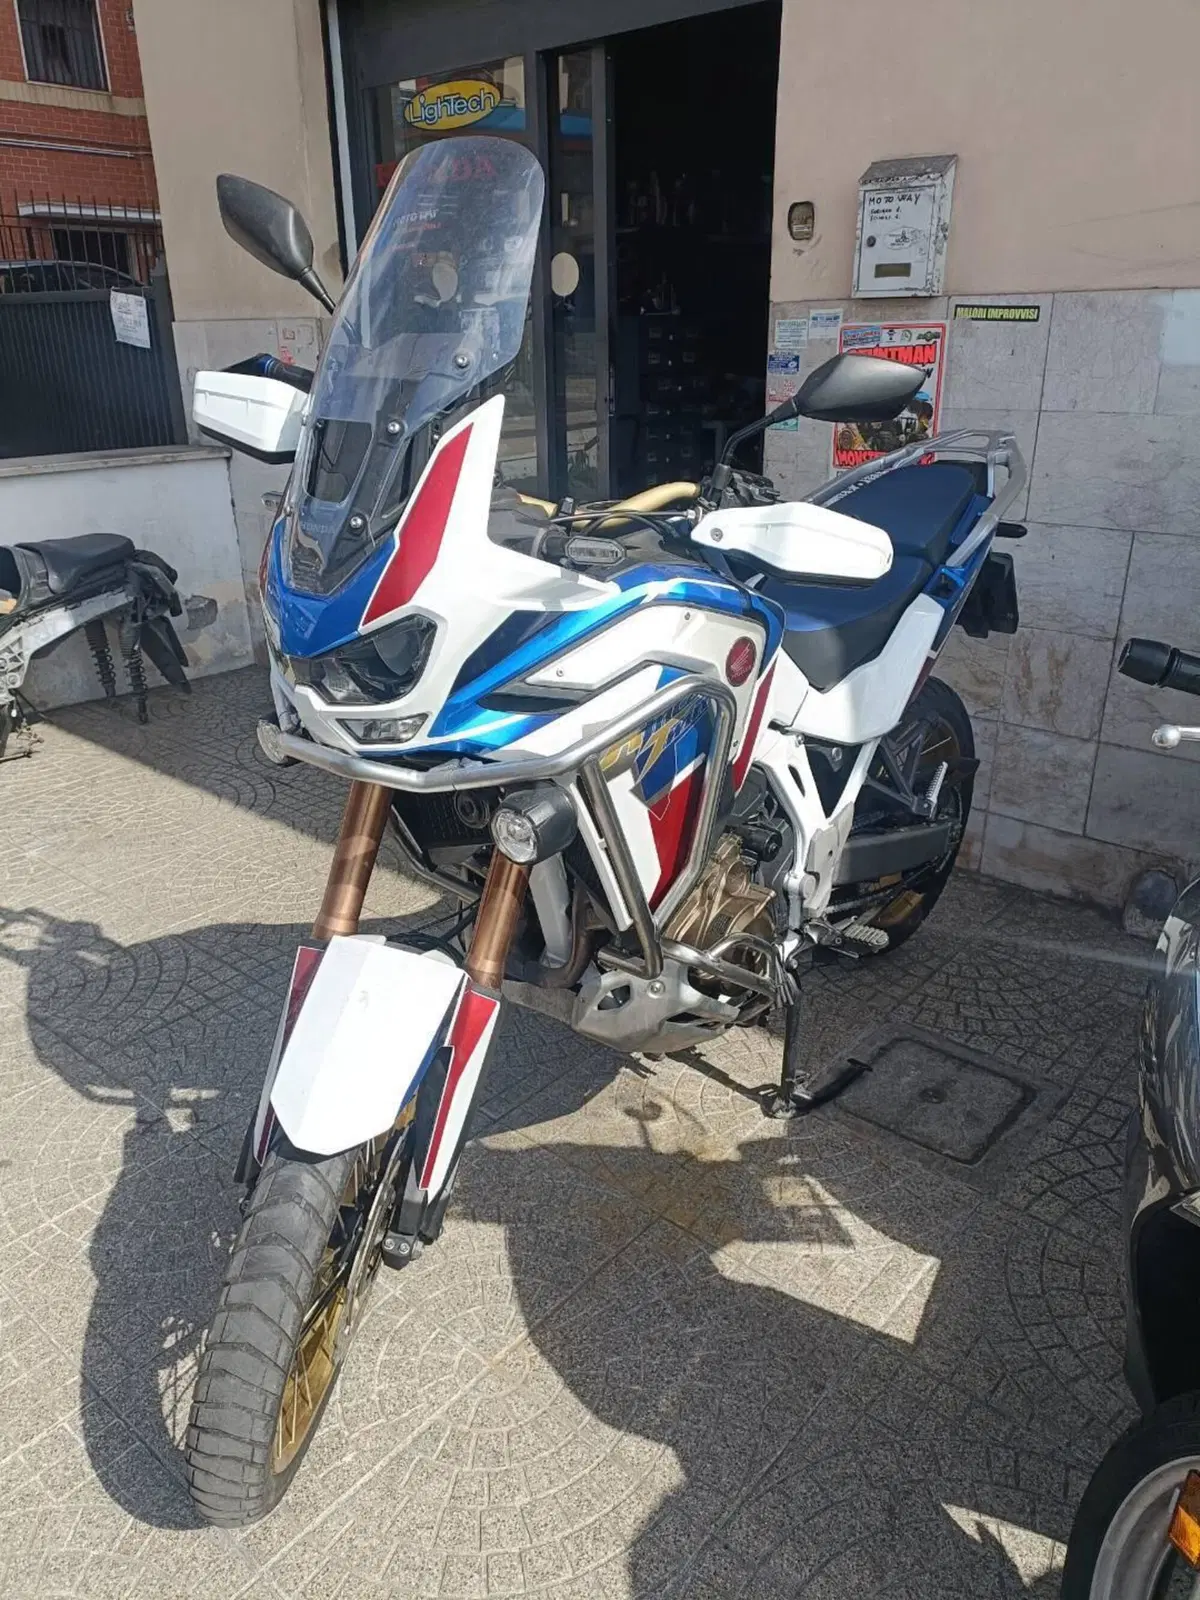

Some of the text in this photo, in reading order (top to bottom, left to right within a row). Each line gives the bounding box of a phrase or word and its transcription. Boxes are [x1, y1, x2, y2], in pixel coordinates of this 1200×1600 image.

[408, 87, 495, 125] LighTech
[957, 308, 1038, 320] MALORI IMPROVVISI
